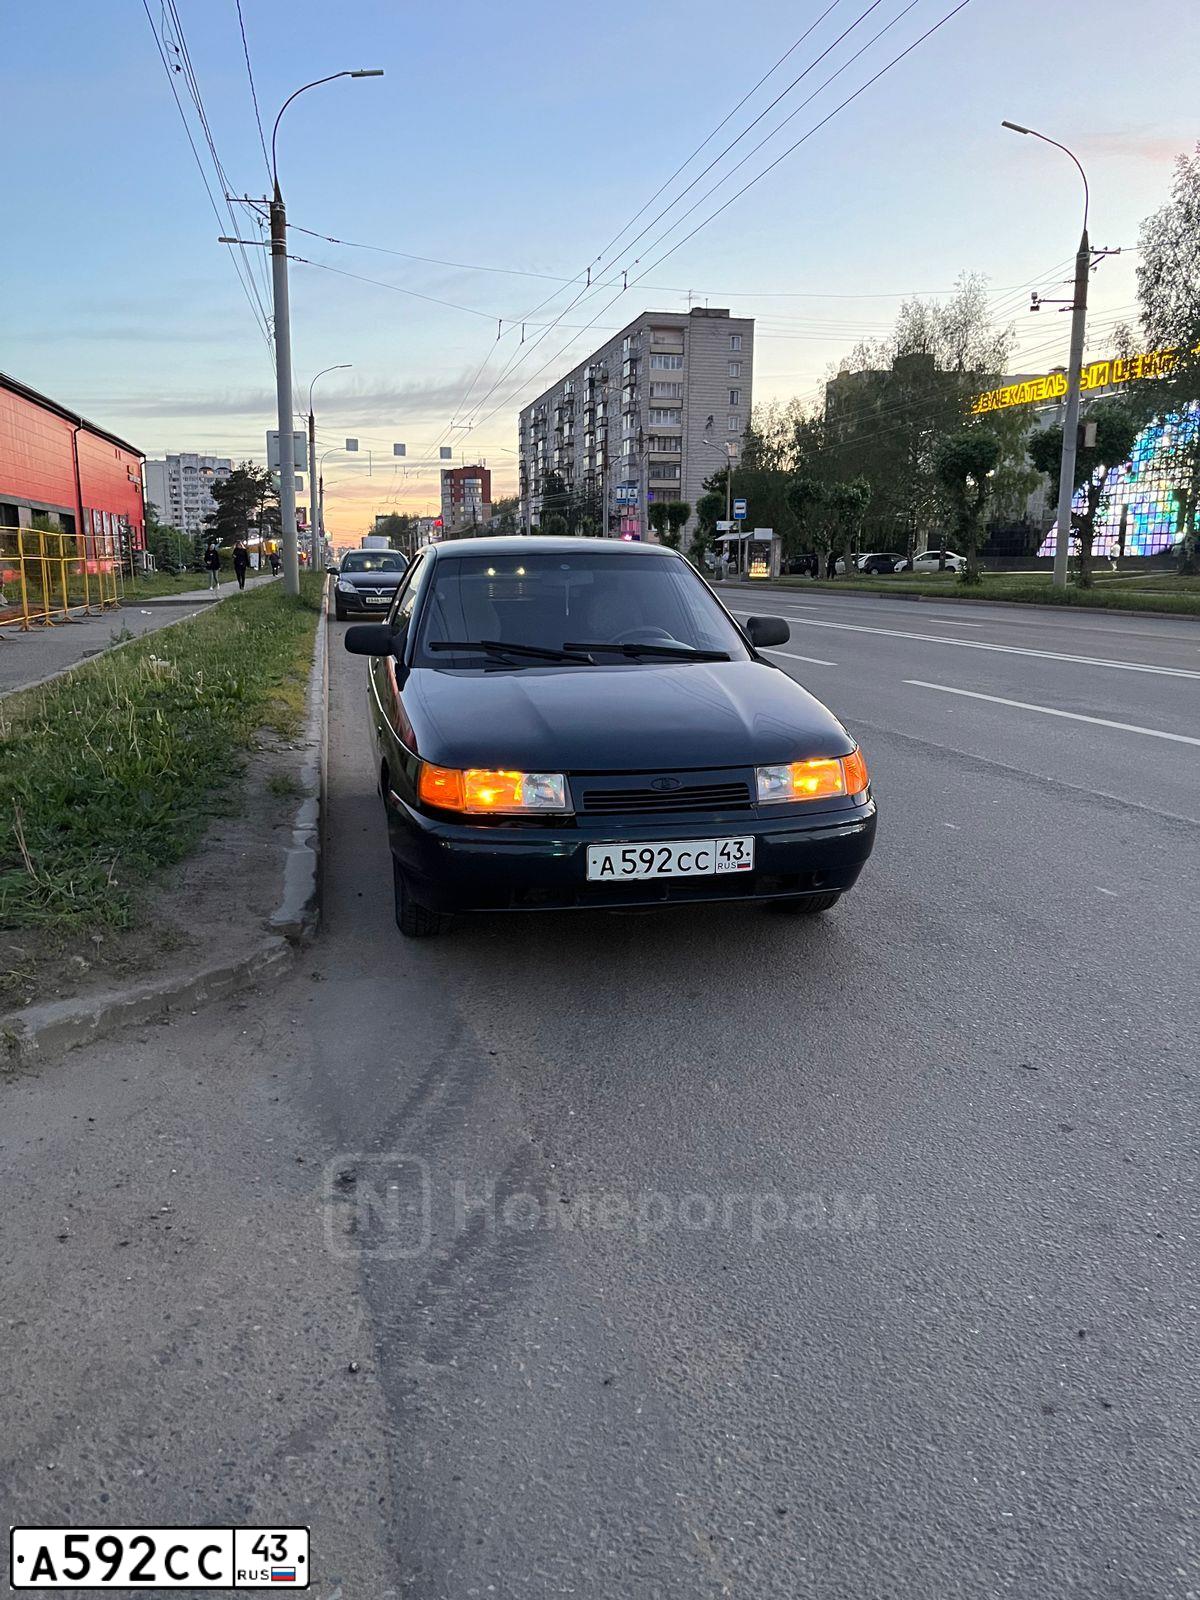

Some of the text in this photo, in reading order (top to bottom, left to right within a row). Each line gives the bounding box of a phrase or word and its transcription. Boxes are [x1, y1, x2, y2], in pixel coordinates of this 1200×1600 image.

[600, 841, 744, 876] А592СС 43
[717, 862, 737, 870] RUS
